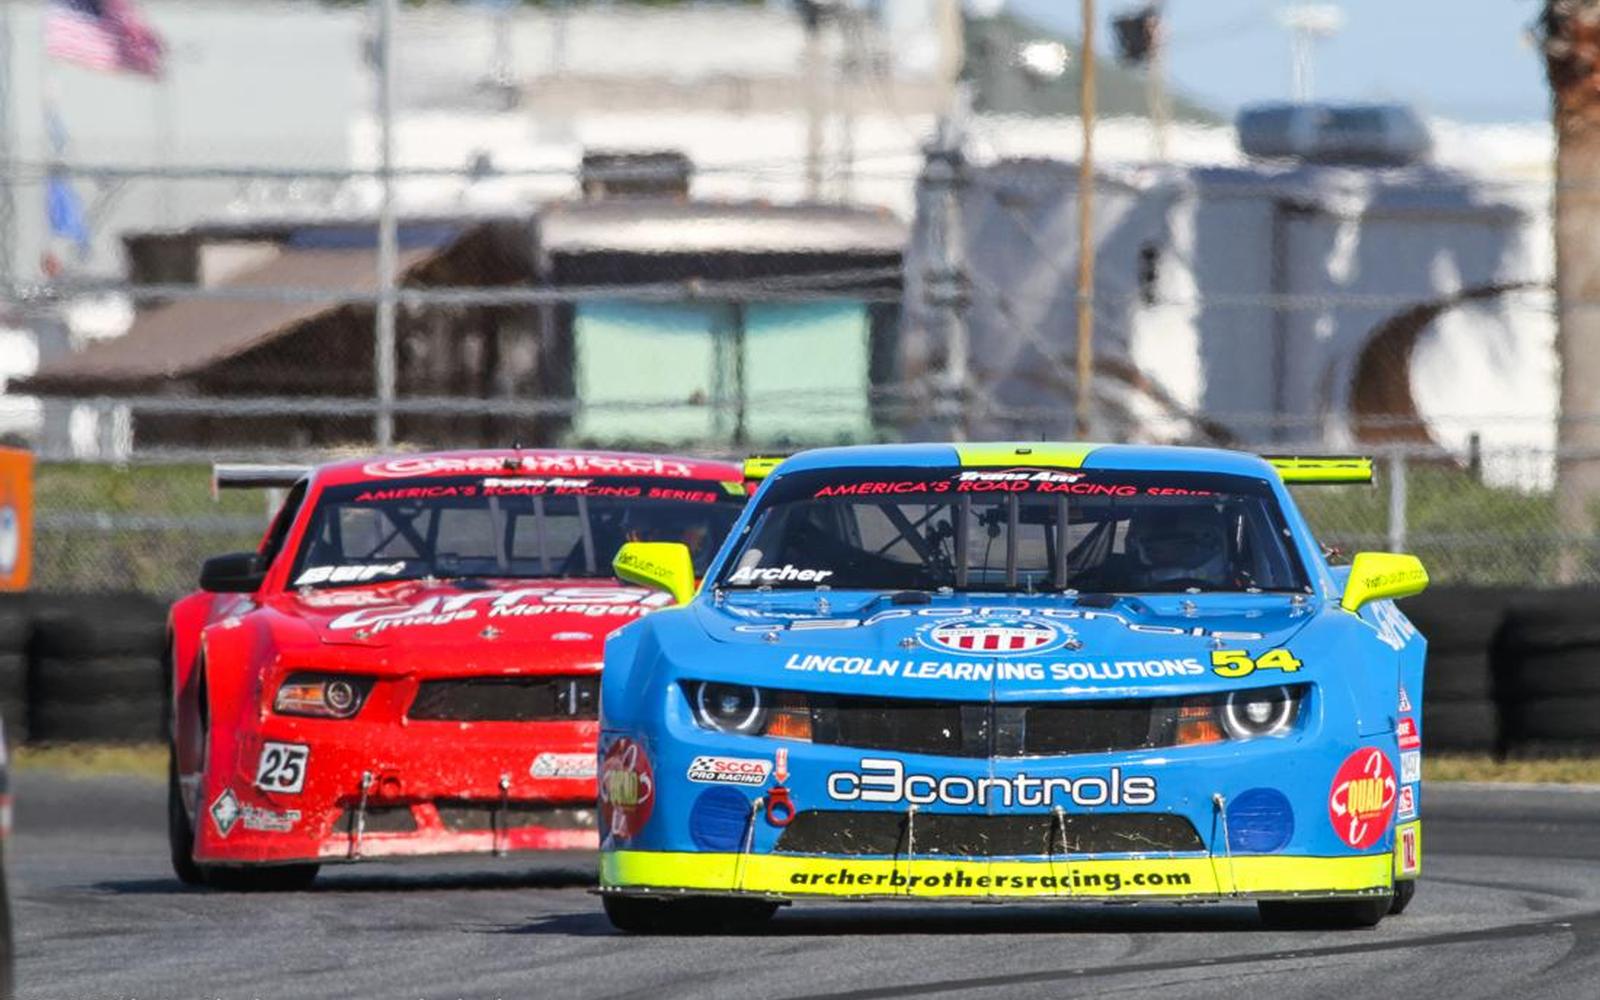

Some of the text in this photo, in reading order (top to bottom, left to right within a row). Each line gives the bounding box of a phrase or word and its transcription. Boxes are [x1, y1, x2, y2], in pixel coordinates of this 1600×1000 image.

[958, 471, 1079, 482] Trans Am
[357, 486, 718, 503] AMERICA'S ROAD RACING SERIES
[814, 481, 951, 498] AMERICA'S
[957, 481, 1030, 492] ROAD
[1036, 483, 1137, 496] RACING
[729, 564, 834, 583] Archer
[372, 609, 476, 634] Image
[785, 654, 1205, 681] LINCOLN LEARNING SOLUTIONS
[1211, 649, 1303, 679] 54
[259, 749, 304, 787] 25
[691, 771, 764, 784] PRO RACING
[715, 761, 764, 774] SCCA
[827, 758, 1156, 807] c3controls
[1348, 778, 1384, 815] QUAD
[790, 869, 1192, 890] archerbrothersracing.com
